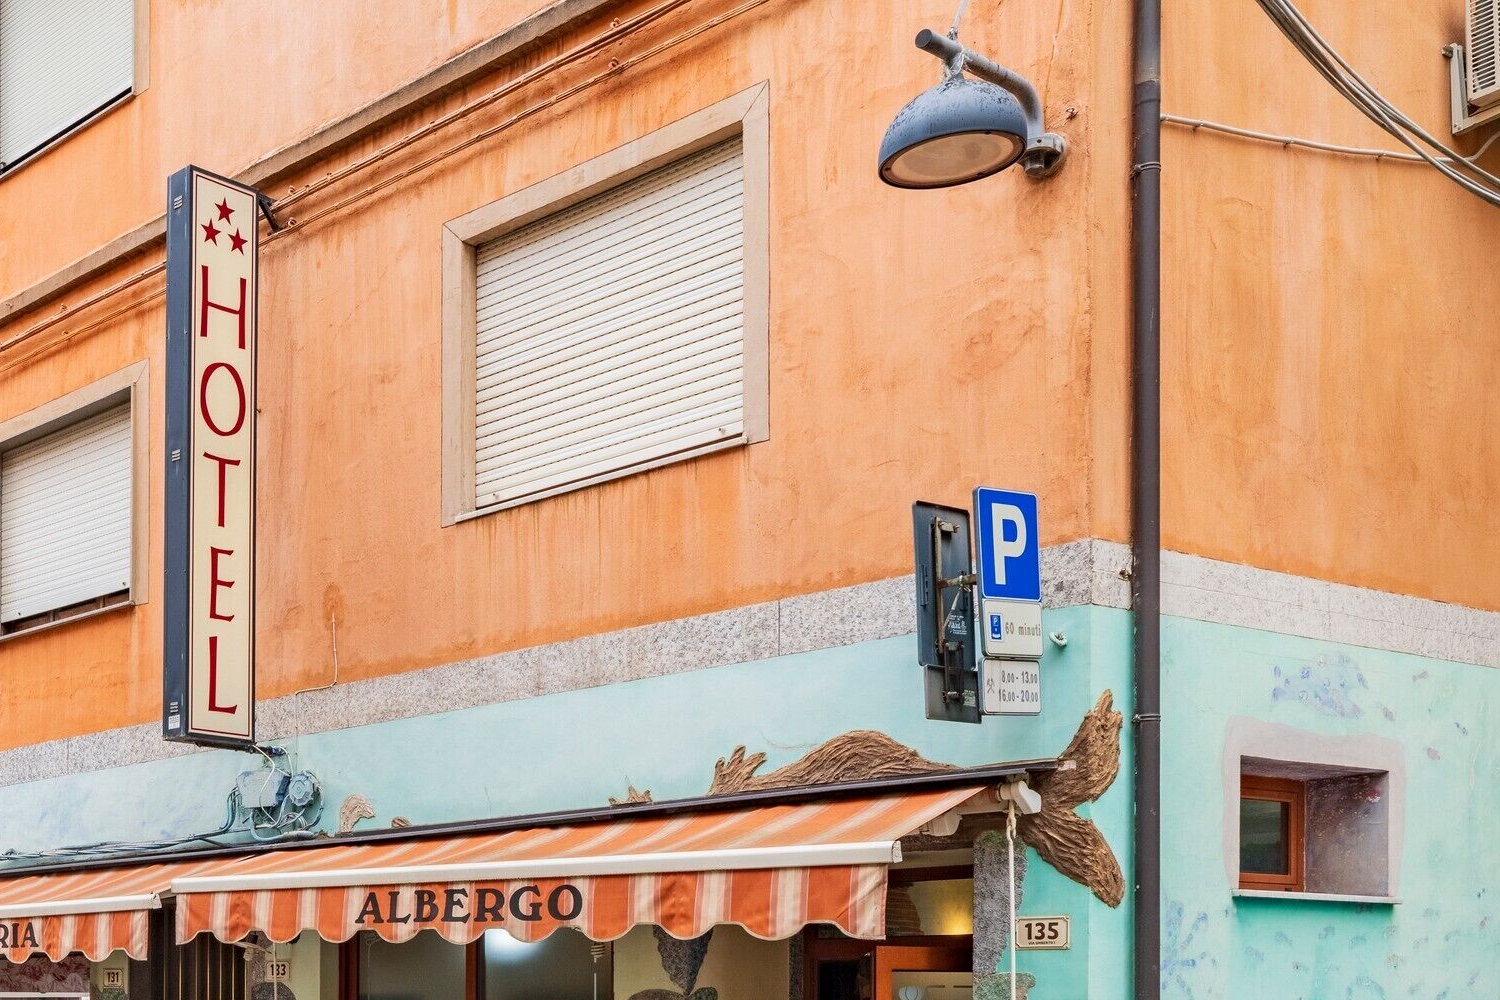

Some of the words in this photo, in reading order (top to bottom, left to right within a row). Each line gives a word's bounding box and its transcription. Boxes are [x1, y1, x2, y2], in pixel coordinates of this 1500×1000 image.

[199, 264, 248, 715] HOTEL
[991, 502, 1027, 586] P
[1004, 622, 1015, 635] 60
[1018, 623, 1041, 637] minuti
[354, 884, 584, 925] ALBERGO
[1024, 921, 1059, 941] 135
[106, 971, 120, 983] 131
[270, 963, 287, 976] 133
